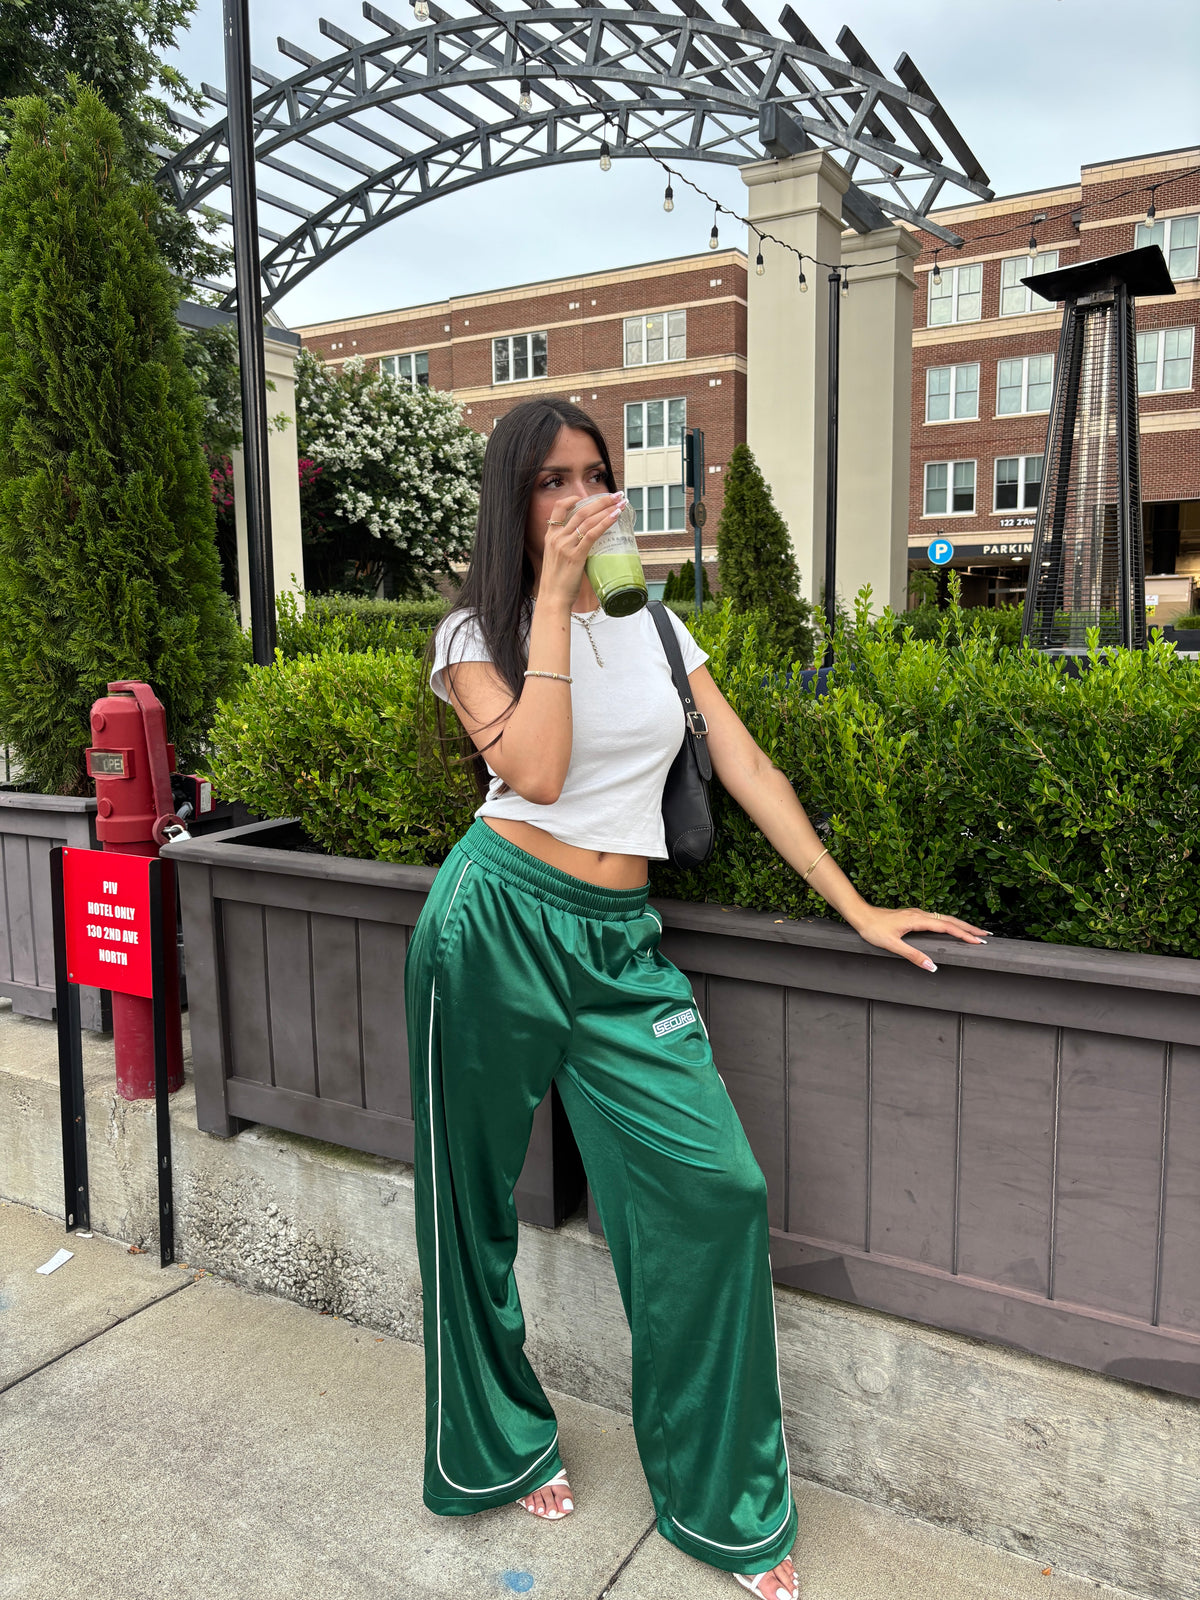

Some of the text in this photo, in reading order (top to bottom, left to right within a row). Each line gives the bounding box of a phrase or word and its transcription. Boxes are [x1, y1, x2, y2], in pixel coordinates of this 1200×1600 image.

[1000, 519, 1015, 527] 122
[935, 543, 948, 559] P
[983, 544, 1033, 554] PARKIN
[103, 758, 124, 771] OPE
[103, 880, 118, 895] PIV
[87, 901, 135, 921] HOTEL ONLY
[86, 924, 139, 945] 130 2ND AVE
[98, 948, 128, 966] NORTH
[656, 1011, 693, 1033] SECURE
